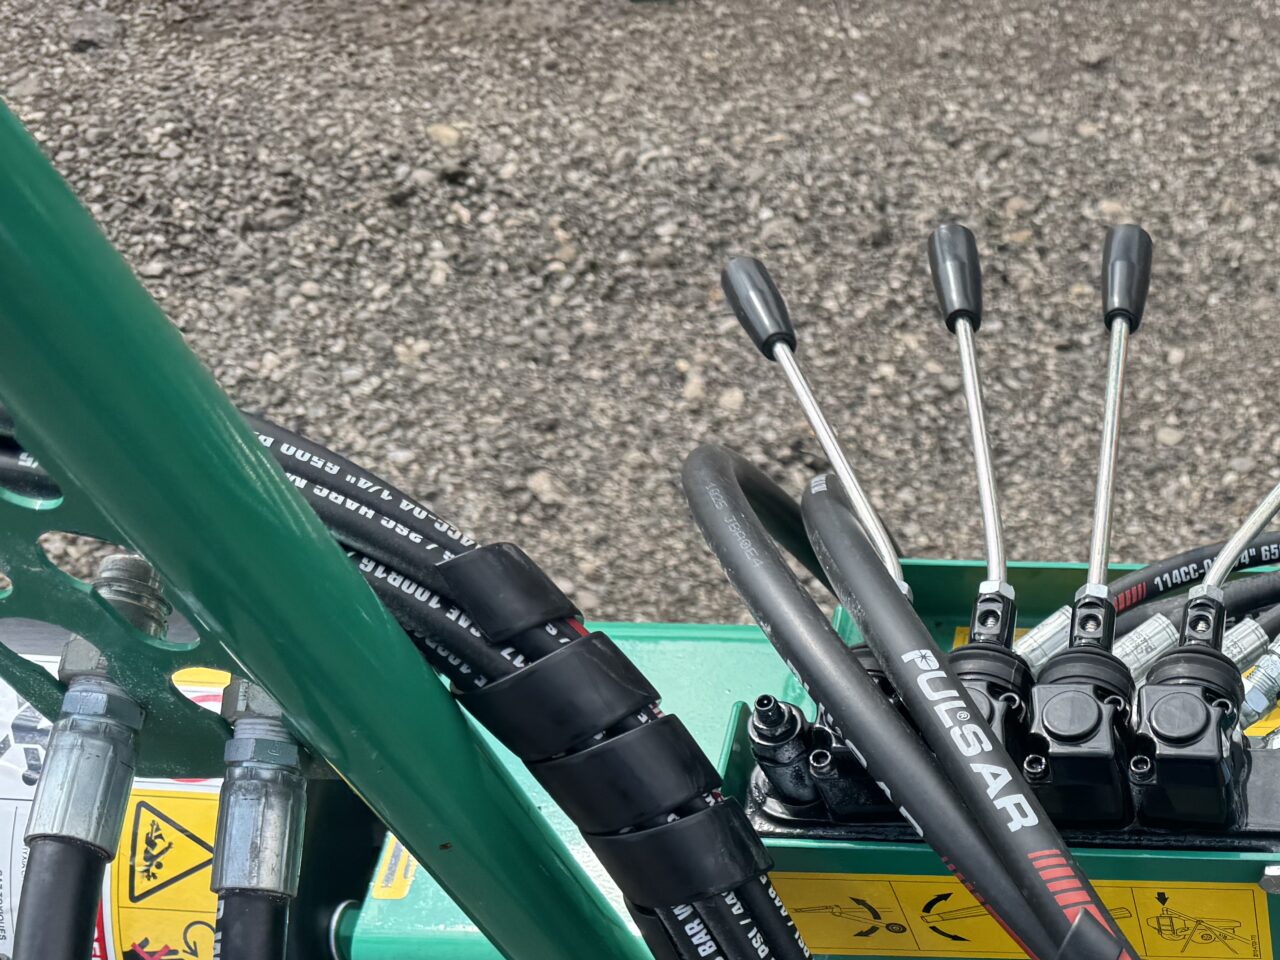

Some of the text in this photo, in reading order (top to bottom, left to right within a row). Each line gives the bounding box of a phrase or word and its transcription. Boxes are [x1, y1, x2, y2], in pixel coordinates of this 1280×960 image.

[1153, 554, 1216, 593] 114CC-0
[683, 917, 718, 958] BAR
[746, 926, 770, 960] PSI
